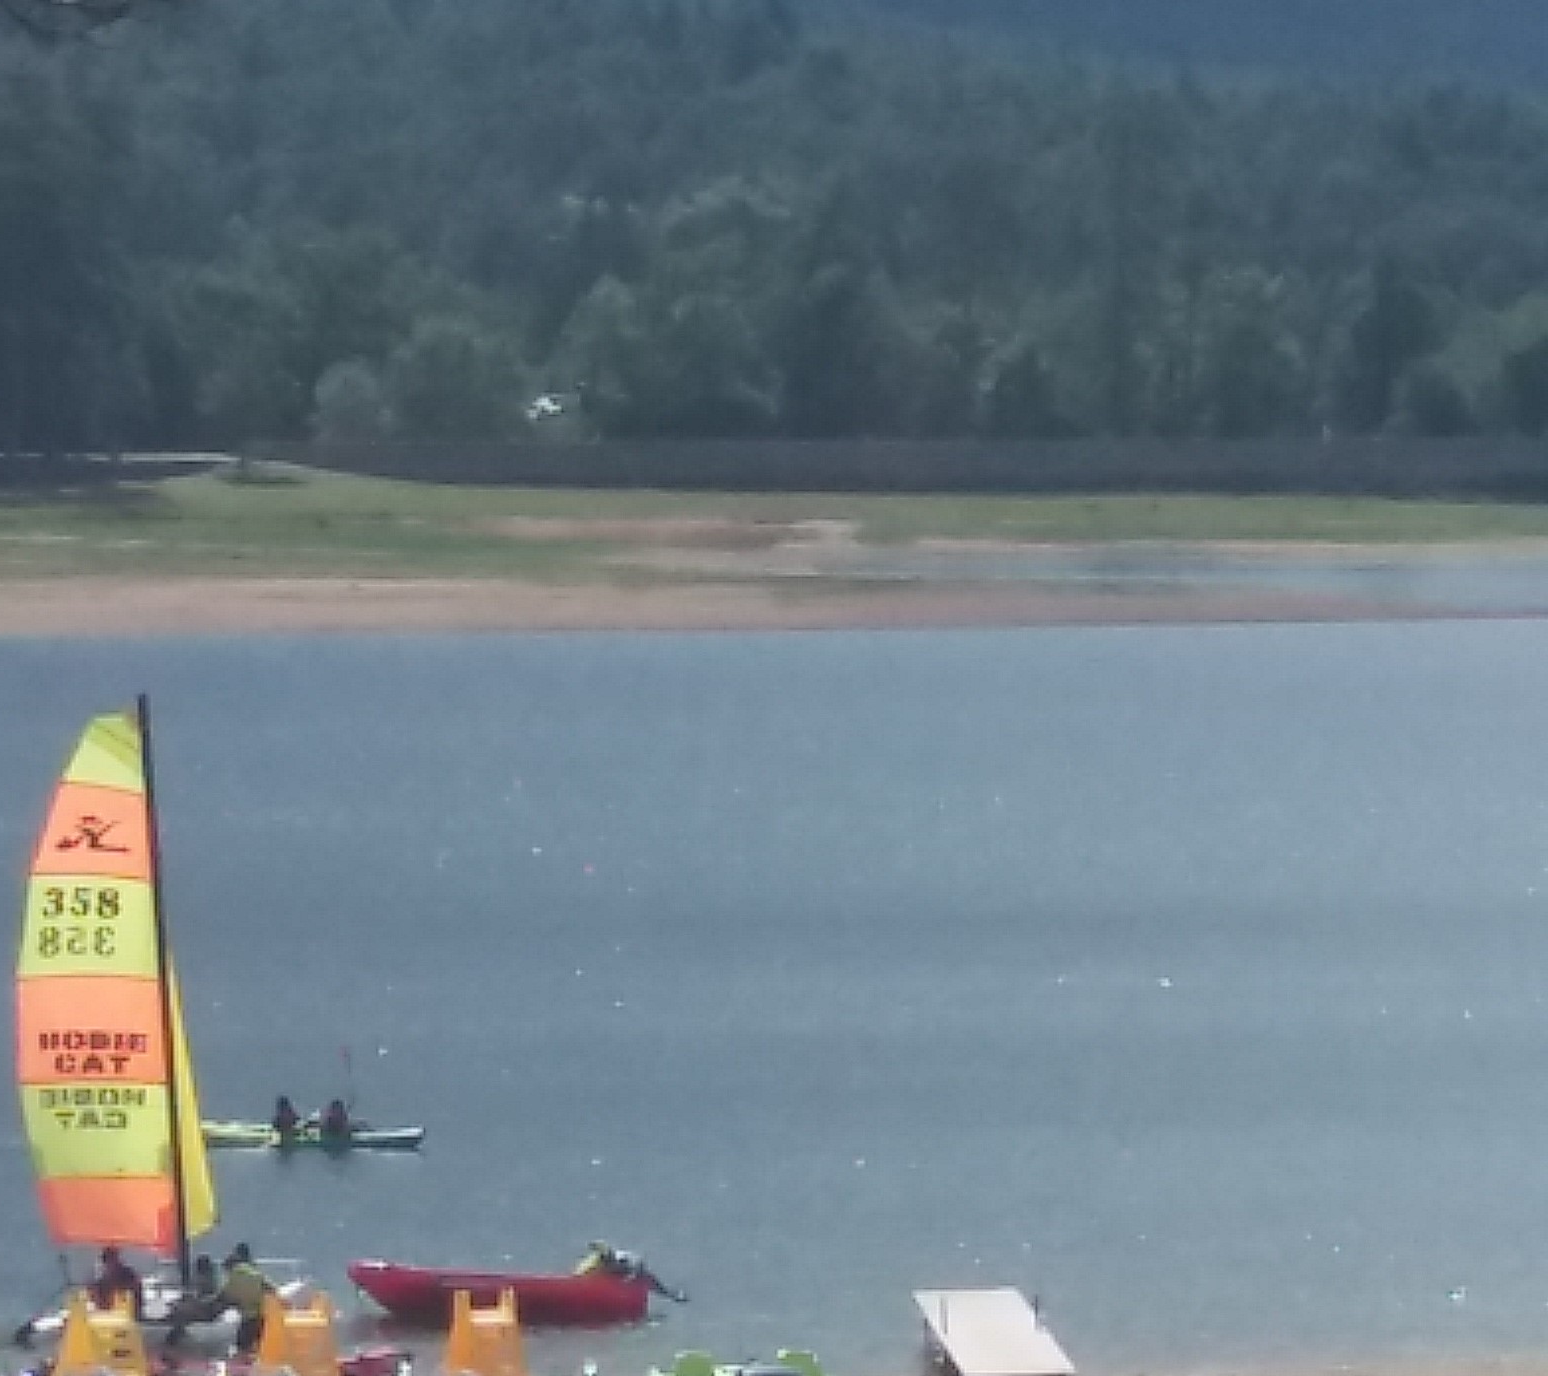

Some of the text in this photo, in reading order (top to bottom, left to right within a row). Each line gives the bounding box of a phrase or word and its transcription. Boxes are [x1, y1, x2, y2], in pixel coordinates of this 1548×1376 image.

[41, 886, 120, 919] 358
[38, 1032, 147, 1052] HOBIE
[54, 1054, 130, 1074] CAT
